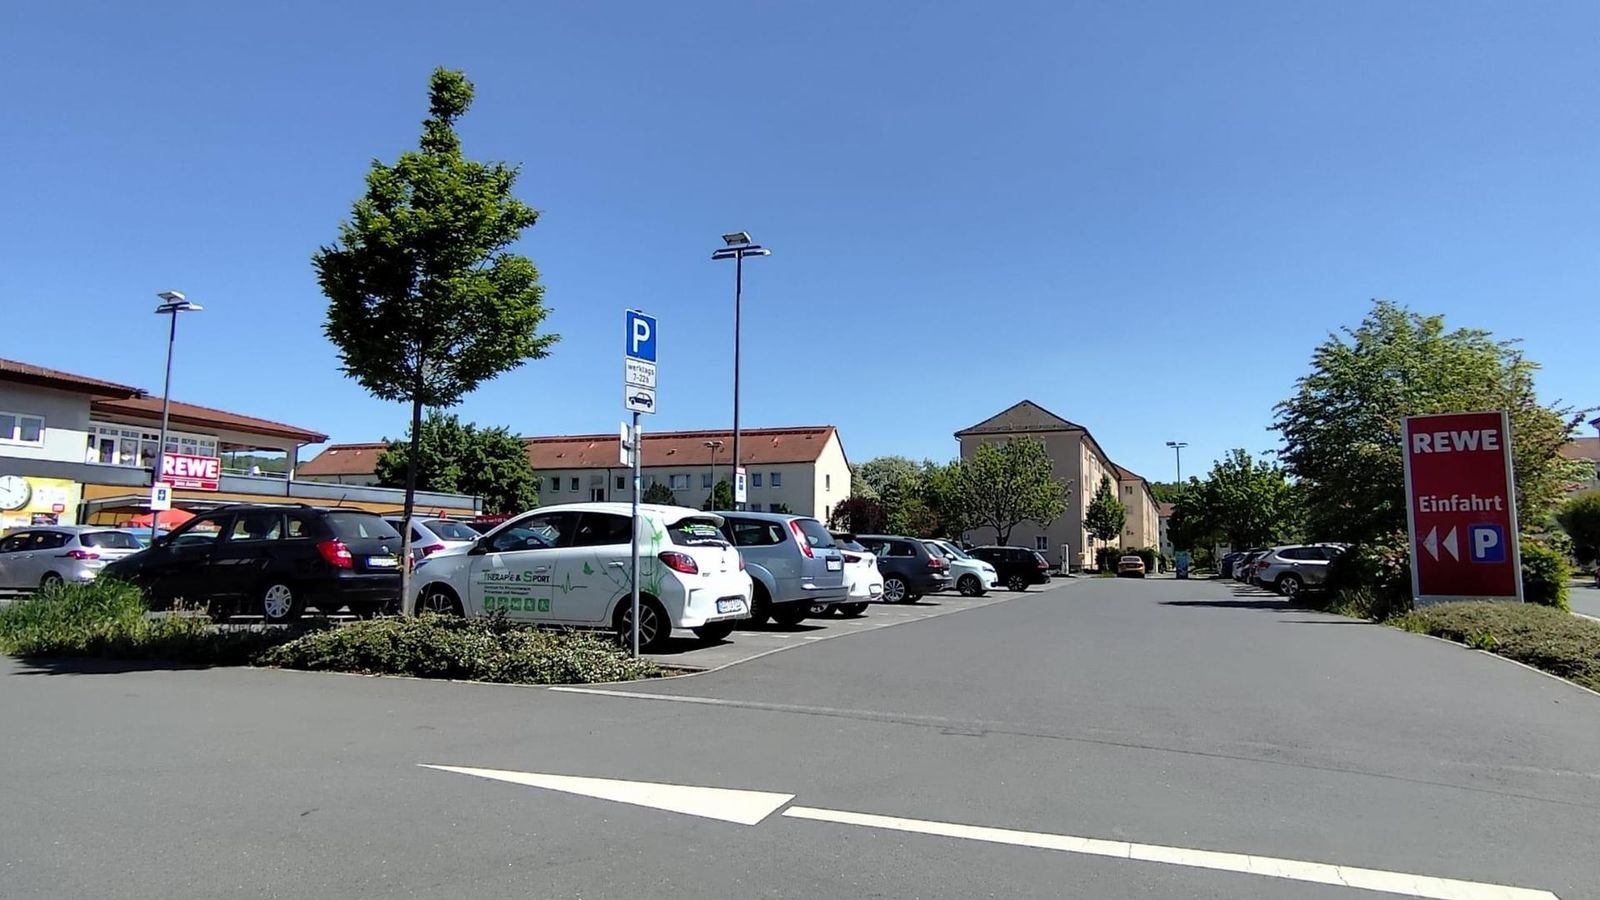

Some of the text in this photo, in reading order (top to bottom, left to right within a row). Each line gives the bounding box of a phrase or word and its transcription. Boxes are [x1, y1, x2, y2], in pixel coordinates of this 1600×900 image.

[633, 318, 650, 353] P
[628, 364, 654, 376] werktags
[1413, 430, 1499, 454] REWE
[162, 456, 217, 478] REWE
[1419, 494, 1502, 512] Einfahrt
[1474, 528, 1499, 558] P
